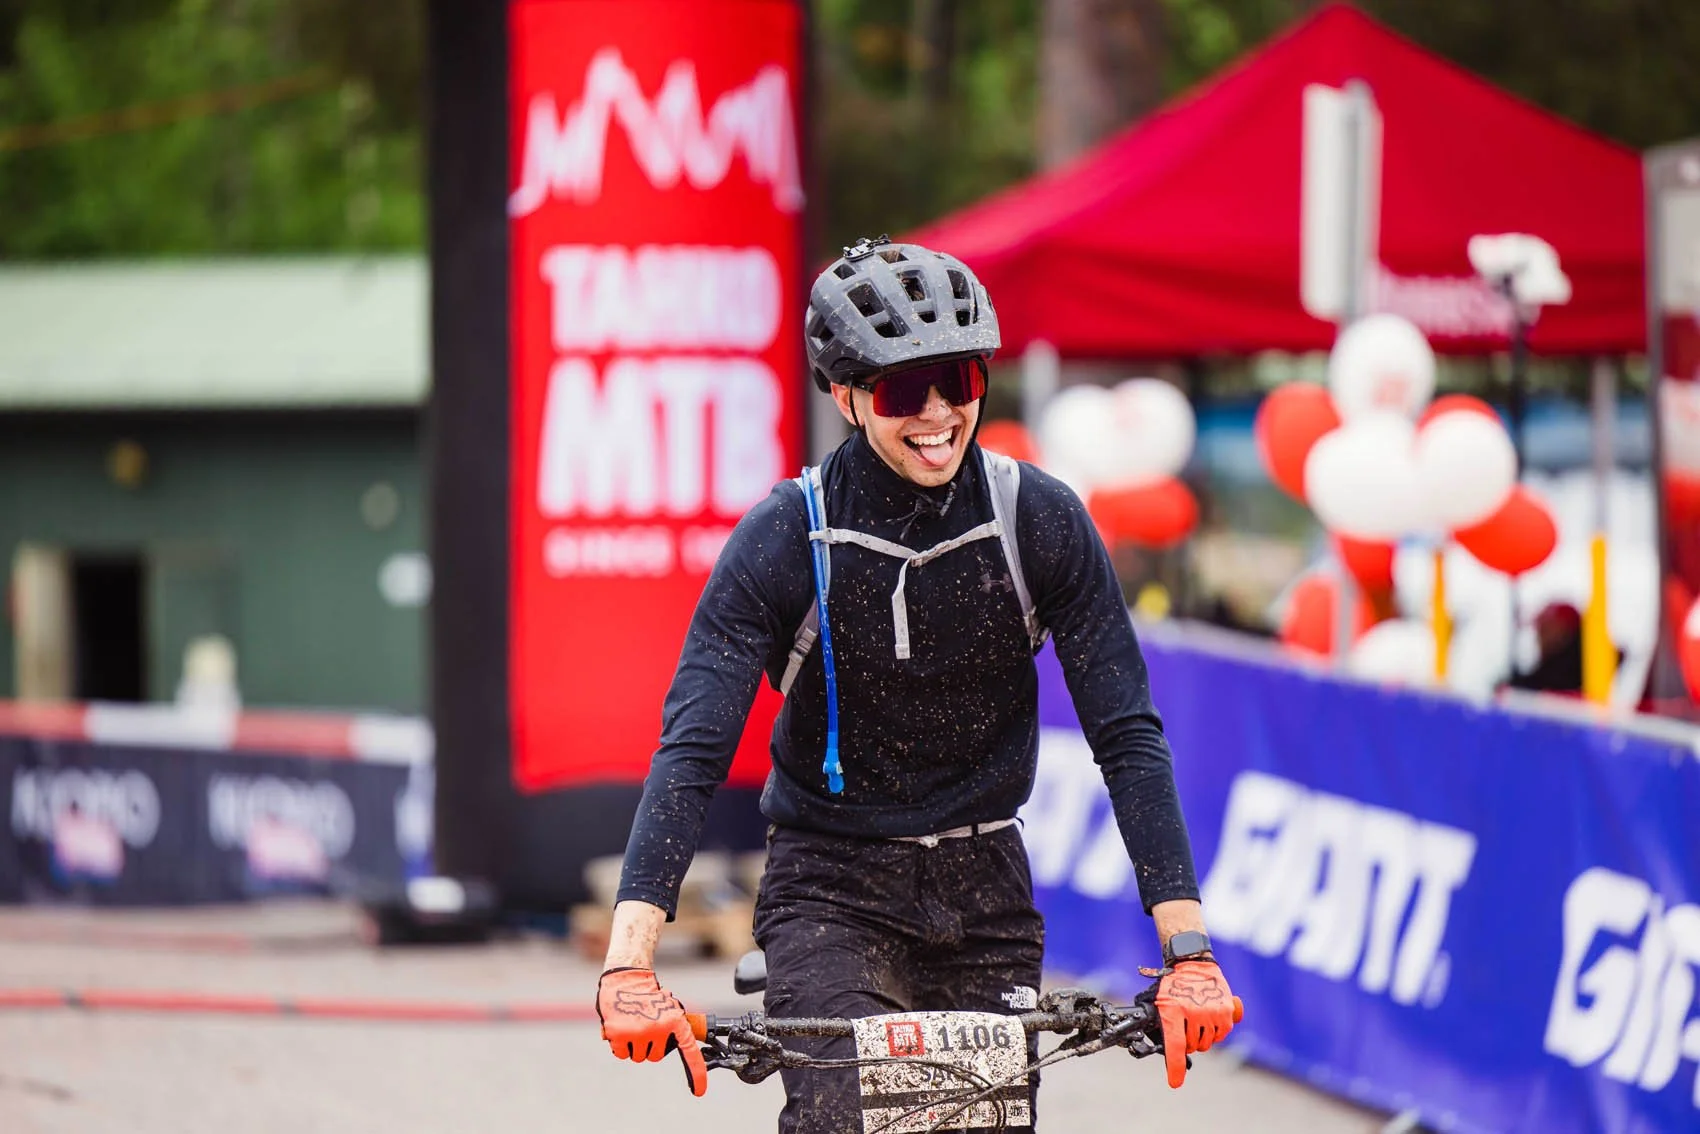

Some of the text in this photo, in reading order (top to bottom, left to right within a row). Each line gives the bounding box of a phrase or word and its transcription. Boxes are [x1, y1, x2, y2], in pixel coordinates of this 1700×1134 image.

[538, 357, 784, 519] MTB
[1198, 769, 1478, 1008] GIANT
[1001, 992, 1029, 1002] NORTH
[1013, 985, 1029, 994] THE
[1543, 866, 1700, 1108] GIA
[1009, 1000, 1029, 1009] FACE
[937, 1024, 1011, 1051] 1106
